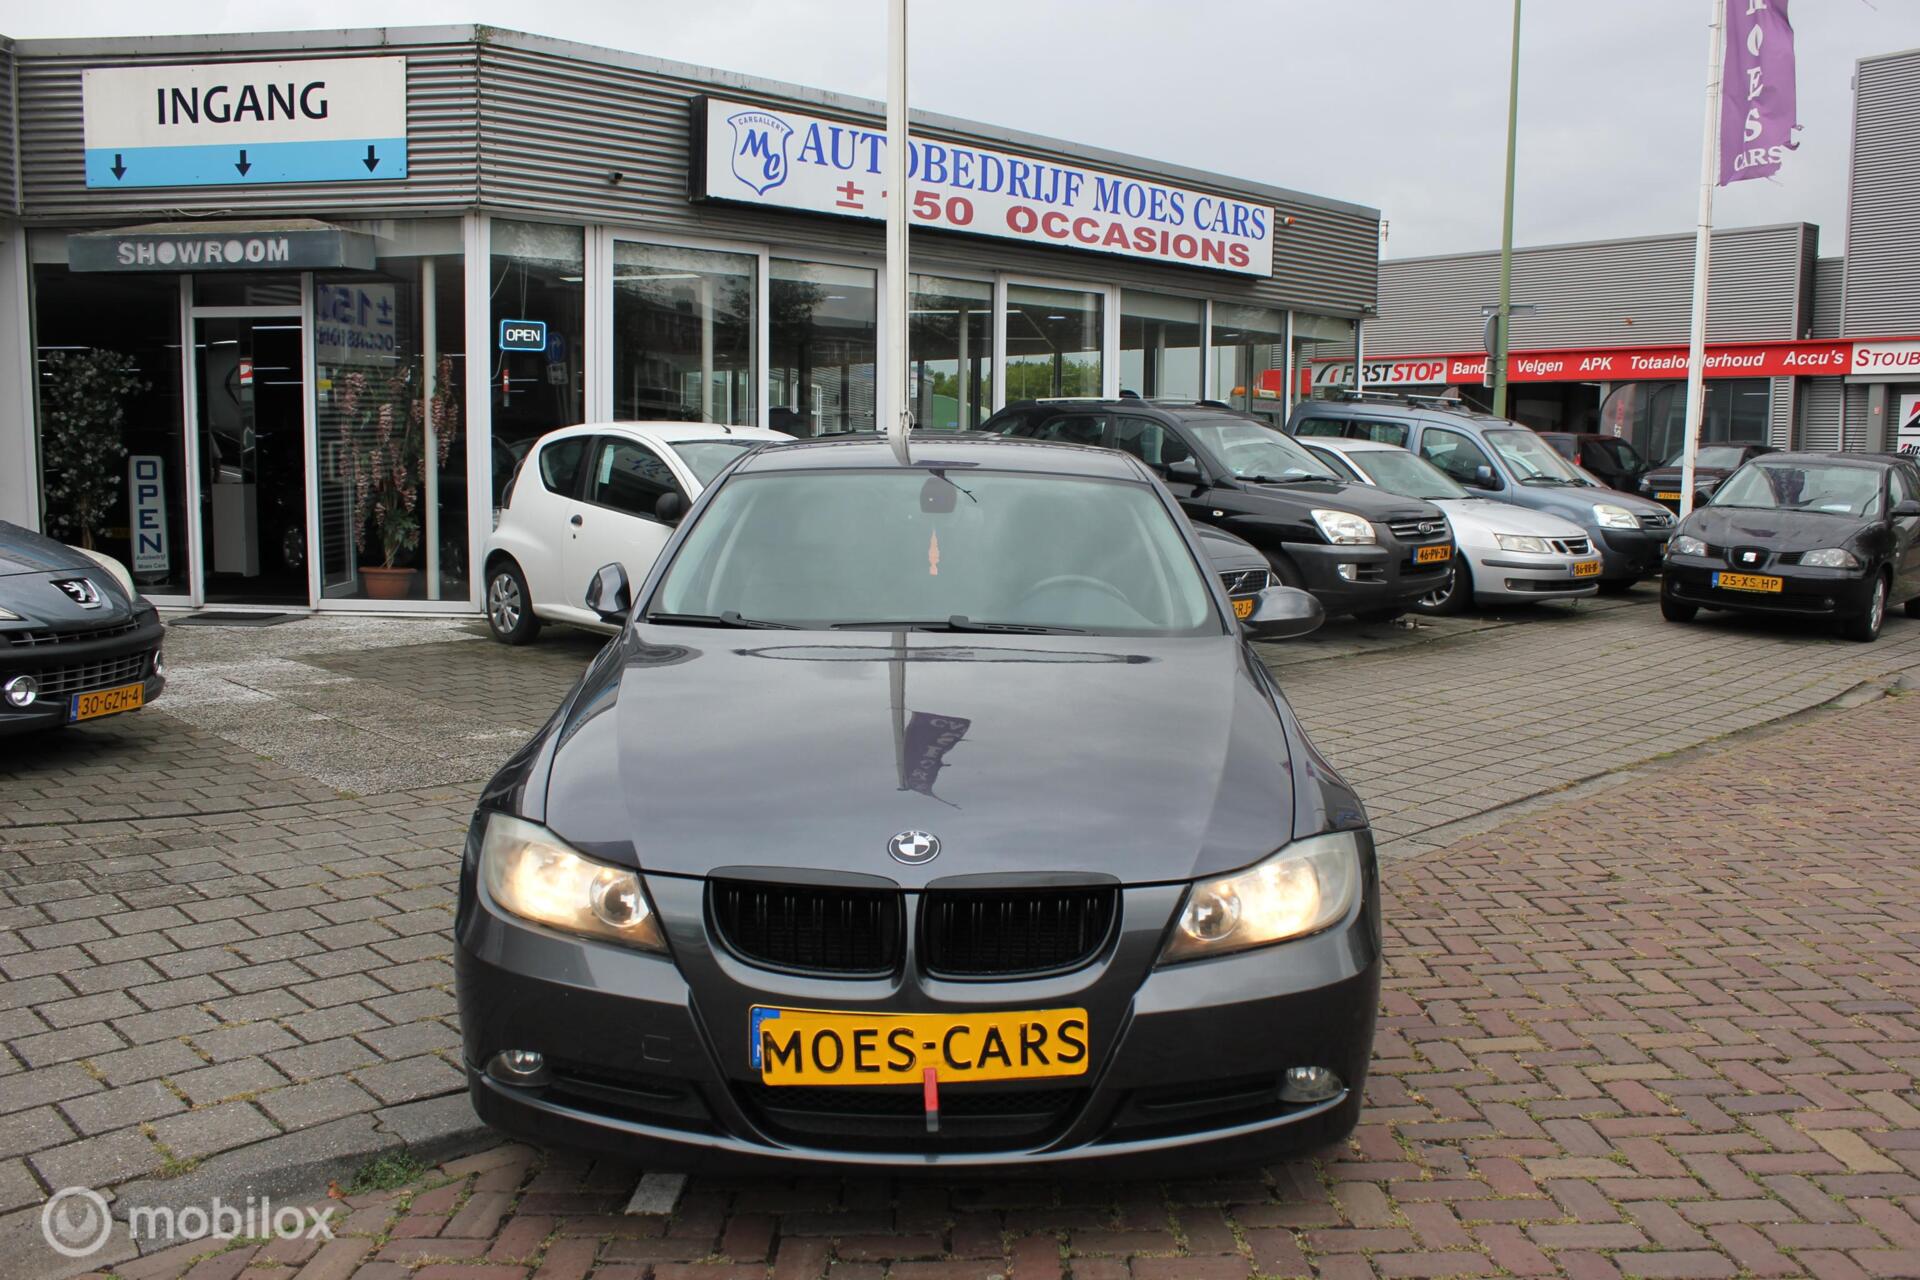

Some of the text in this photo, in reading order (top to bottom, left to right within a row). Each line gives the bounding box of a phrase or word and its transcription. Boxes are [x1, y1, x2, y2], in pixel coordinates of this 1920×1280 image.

[157, 81, 328, 125] INGANG
[738, 116, 784, 134] CARGALLERY
[1734, 145, 1784, 172] CARS
[1093, 177, 1185, 226] MOES
[1193, 197, 1266, 241] CARS
[882, 189, 974, 226] 50
[1006, 205, 1250, 268] OCCASIONS
[117, 238, 289, 265] SHOWROOM
[505, 329, 541, 342] OPEN
[1452, 362, 1486, 376] Band
[1517, 359, 1563, 376] Velgen
[1579, 357, 1614, 372] APK
[1784, 350, 1844, 367] Accu's
[136, 460, 162, 554] OPEN
[1721, 574, 1779, 590] 25-XS-HP
[81, 687, 139, 716] 30-GZH-4
[761, 1019, 1087, 1074] MOES-CARS
